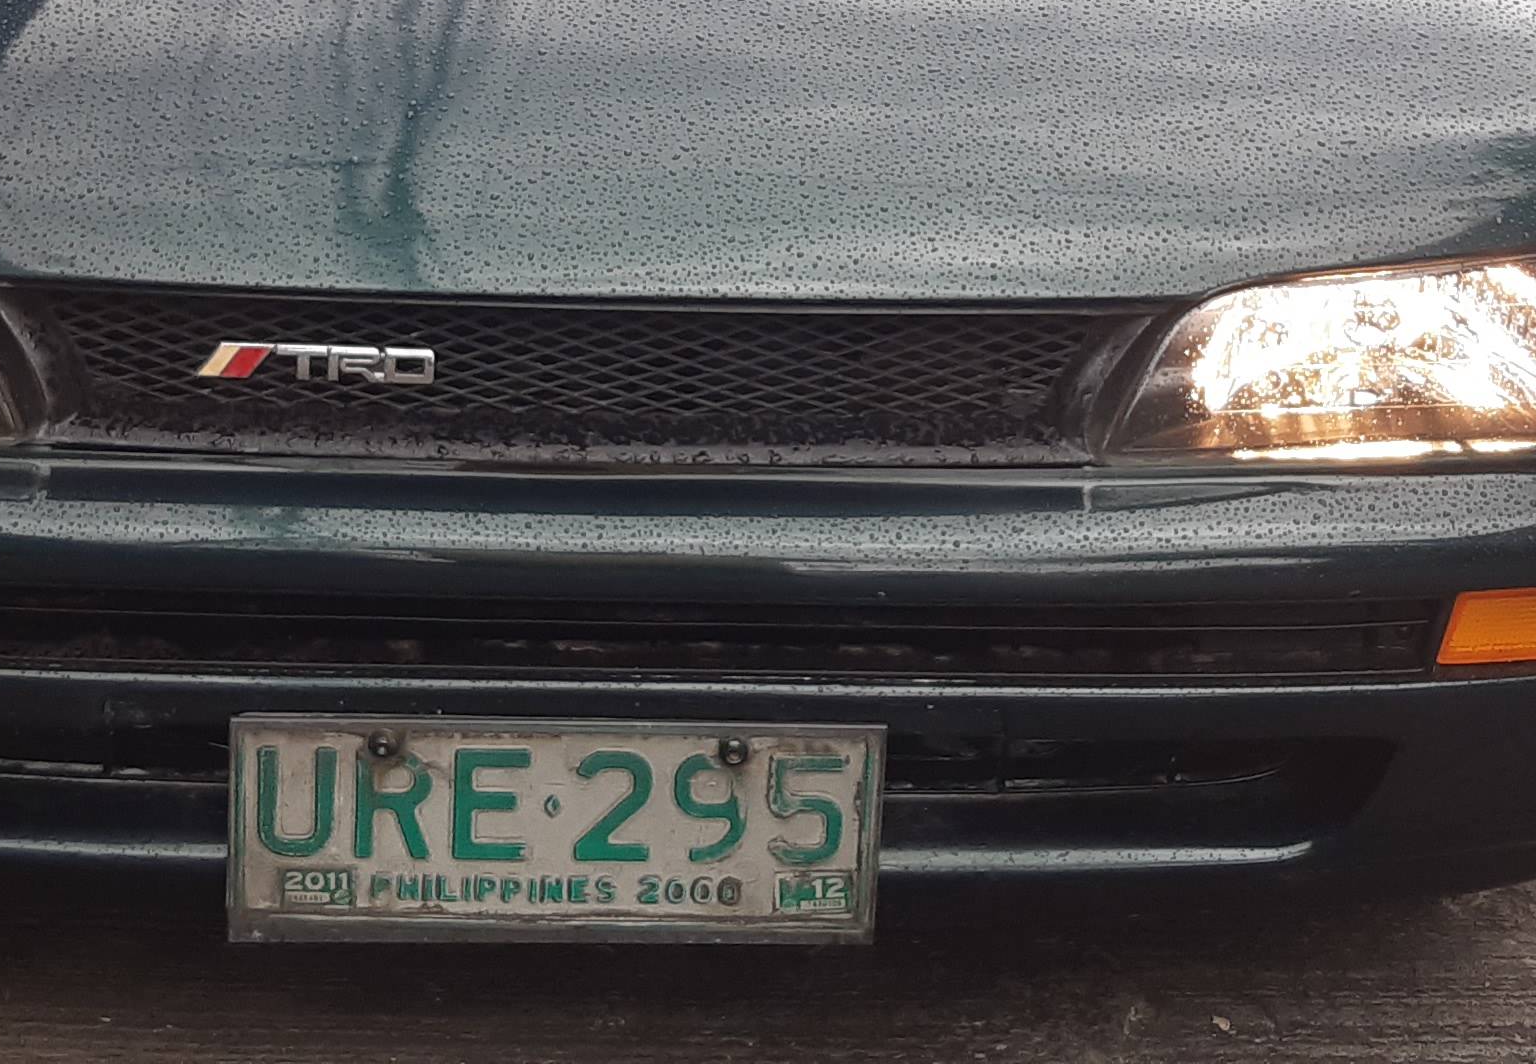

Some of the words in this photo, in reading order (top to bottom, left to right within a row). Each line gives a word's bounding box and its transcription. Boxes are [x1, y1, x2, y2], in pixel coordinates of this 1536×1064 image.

[276, 343, 435, 384] TRD
[284, 871, 350, 891] 2011
[370, 871, 615, 907] PHILIPPINES
